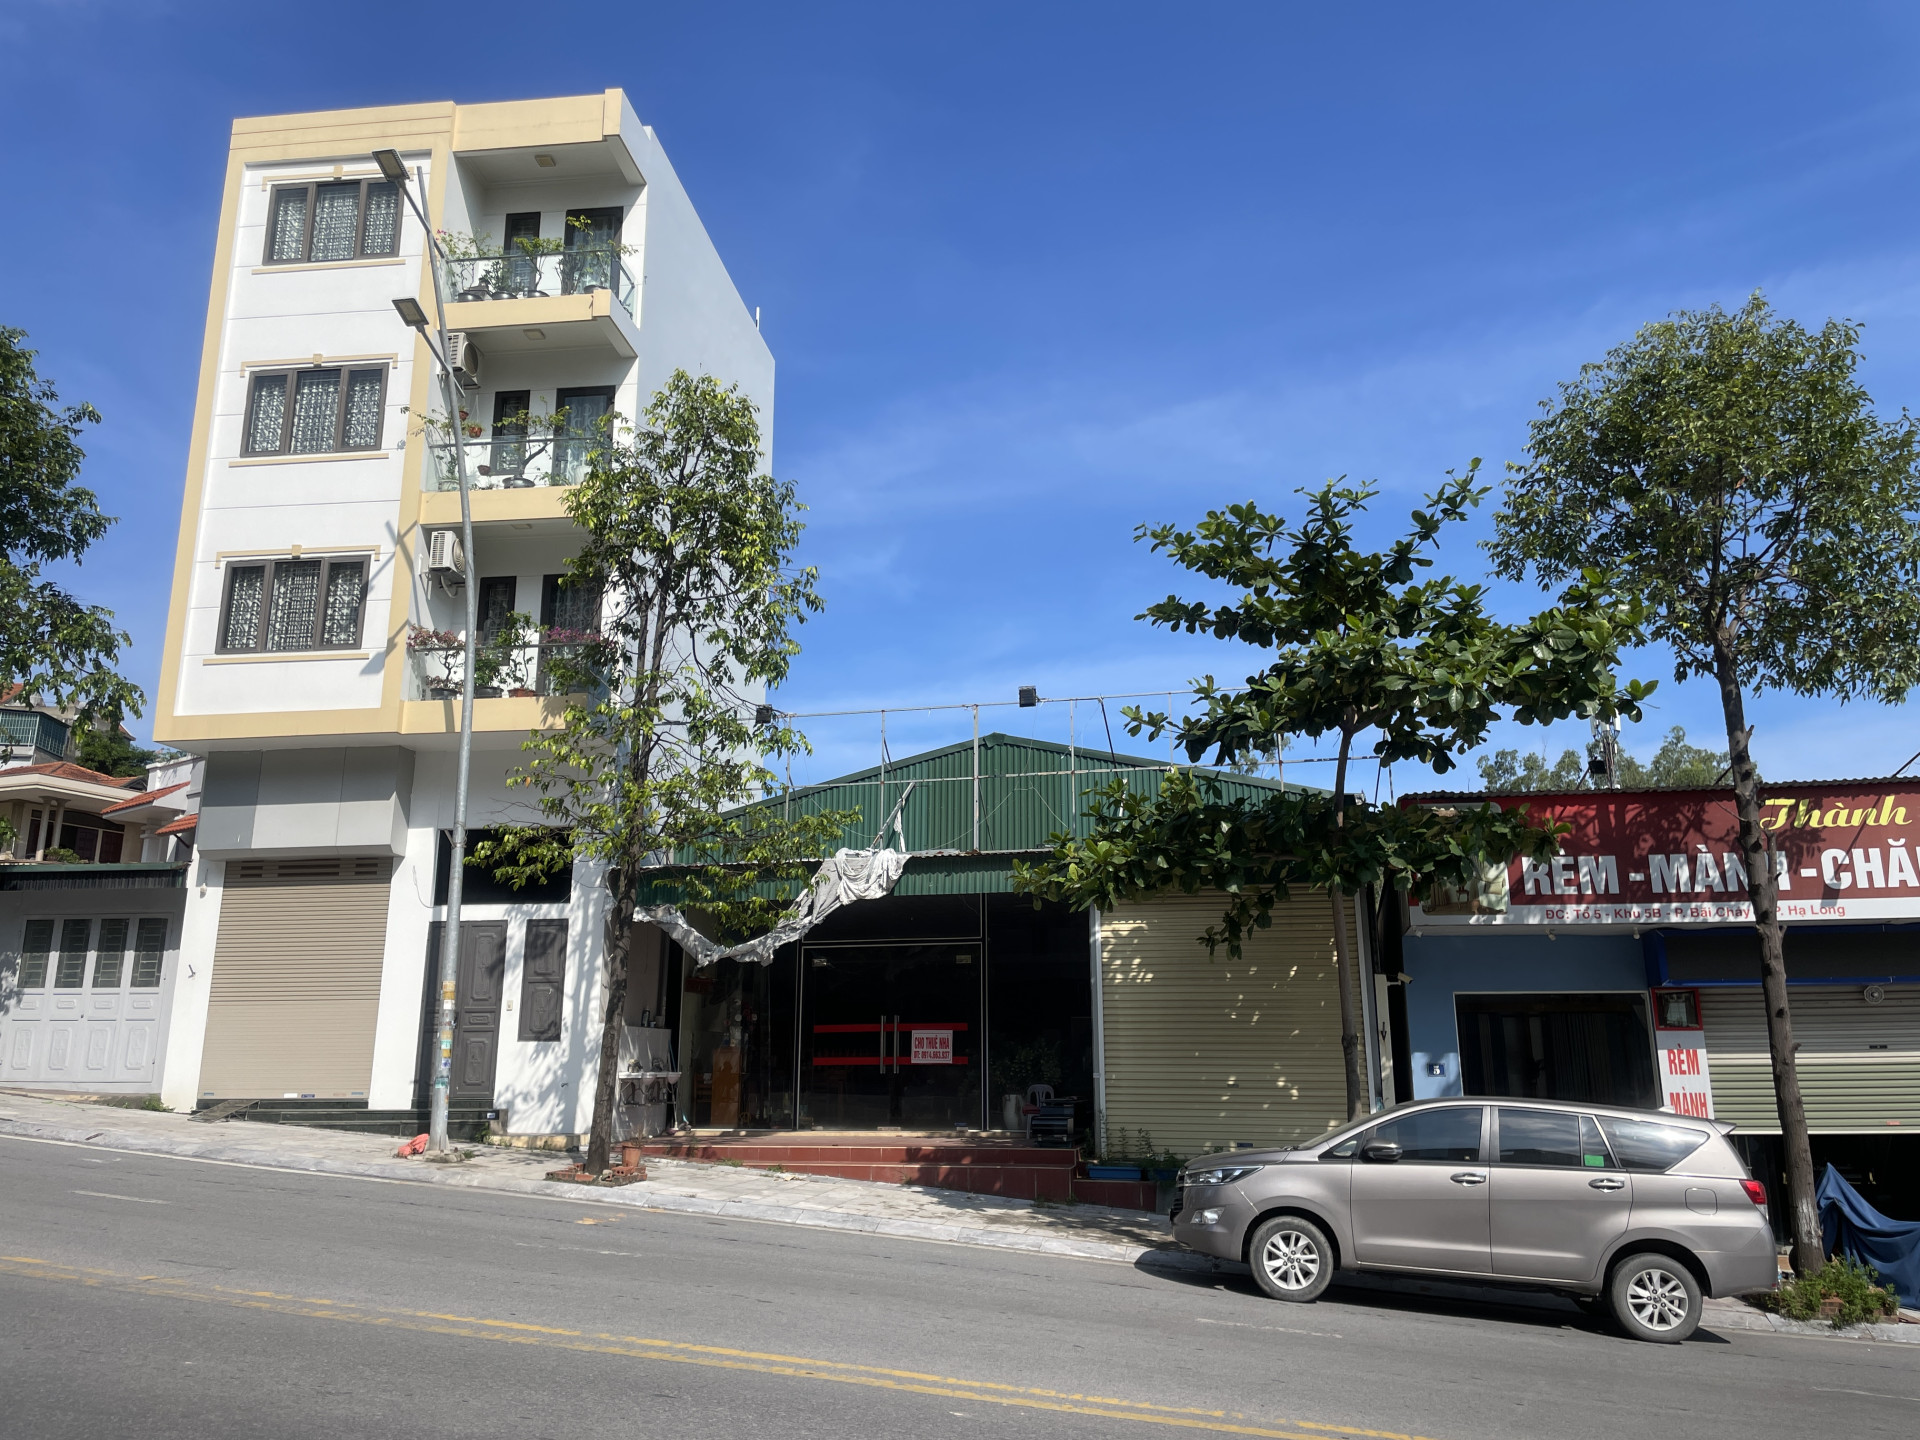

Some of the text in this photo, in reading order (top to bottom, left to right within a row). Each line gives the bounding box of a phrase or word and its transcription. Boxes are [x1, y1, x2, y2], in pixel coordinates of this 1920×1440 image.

[1760, 795, 1912, 830] Thành
[1521, 848, 1620, 895] RÈM
[1821, 838, 1920, 889] CHĂ
[1545, 909, 1570, 919] ĐC:
[1575, 906, 1590, 919] Tổ
[1594, 909, 1601, 919] 5
[1614, 907, 1641, 919] Khu
[1645, 908, 1661, 918] 5B
[1675, 907, 1686, 918] P.
[1690, 906, 1712, 918] Bãi
[1788, 905, 1806, 918] Hạ
[1811, 904, 1846, 917] Long
[1433, 1065, 1441, 1075] 5
[1667, 1043, 1701, 1075] RÈM
[1669, 1086, 1709, 1118] MÀNH
